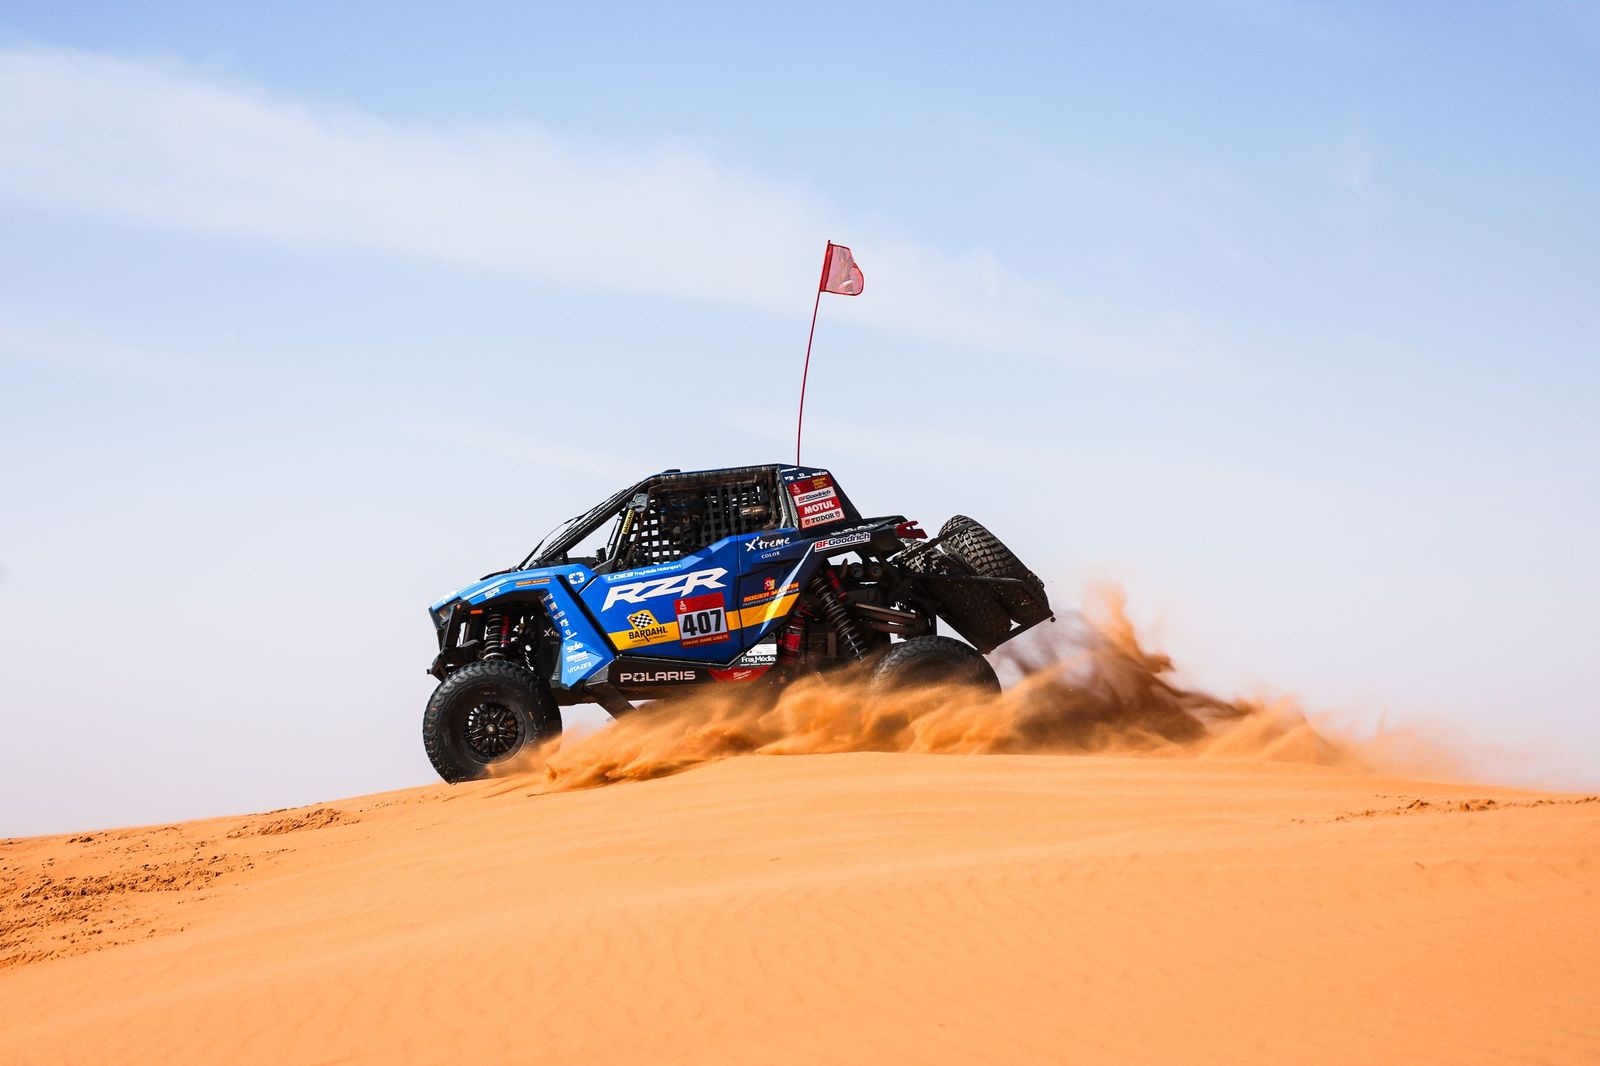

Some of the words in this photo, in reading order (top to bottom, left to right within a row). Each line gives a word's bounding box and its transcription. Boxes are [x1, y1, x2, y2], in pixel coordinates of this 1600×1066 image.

[798, 490, 831, 503] BFGoodrich
[804, 500, 835, 515] MOTUL
[811, 512, 835, 524] TUDOR
[815, 532, 870, 550] BFGoodrich
[761, 550, 780, 559] COLOR
[601, 567, 729, 613] RZR
[743, 592, 770, 603] ROGER
[770, 582, 799, 597] MARTIN
[682, 609, 722, 637] 407
[628, 626, 669, 640] BARDAHL
[741, 655, 777, 663] FrayMédia
[620, 670, 696, 683] POLARIS
